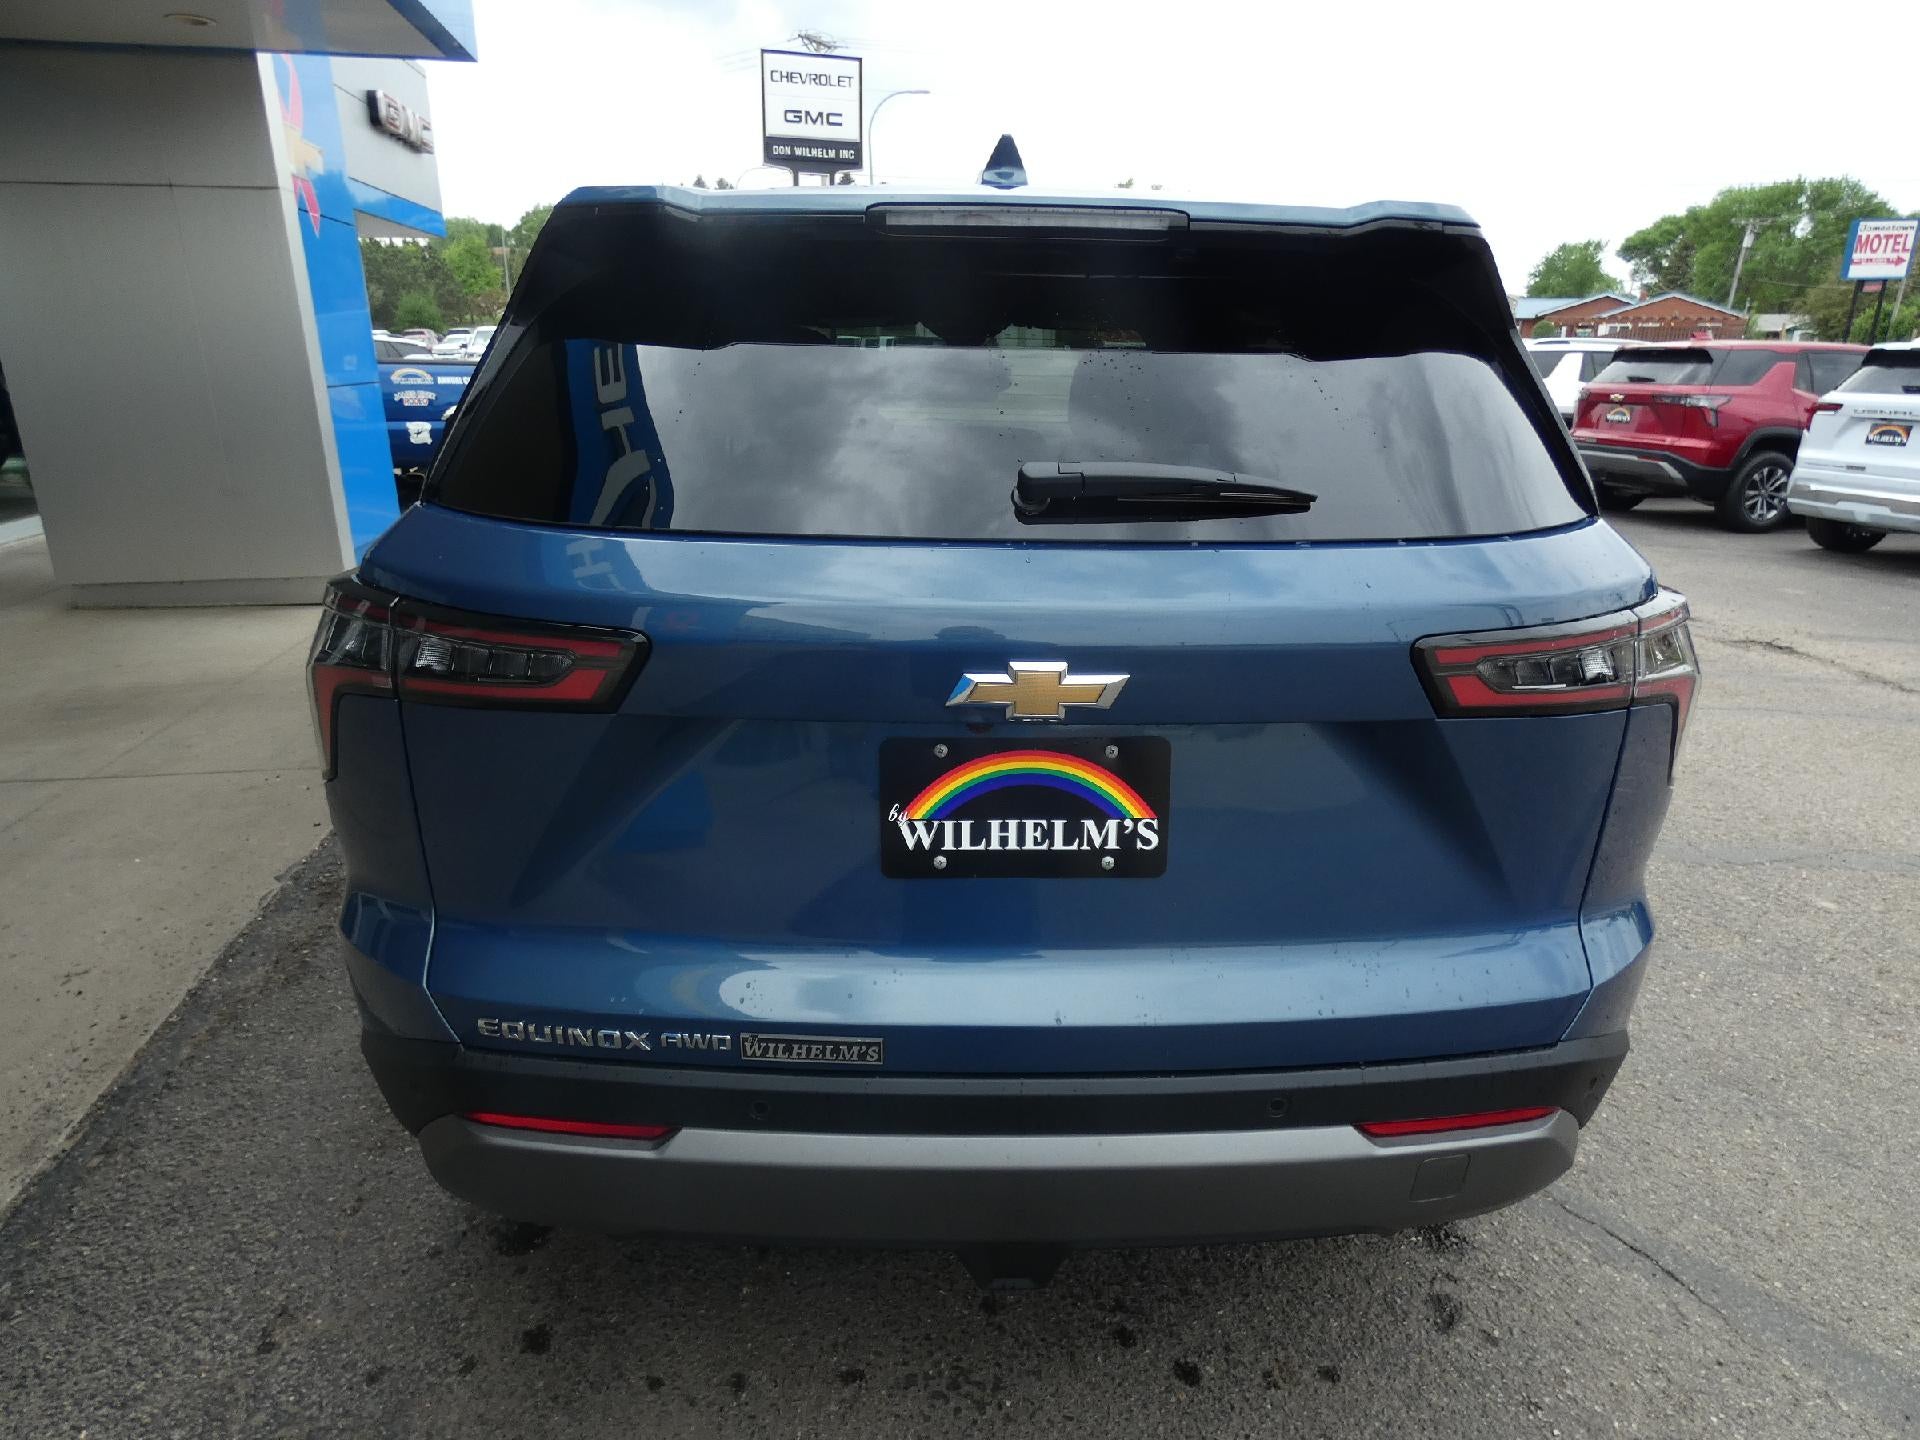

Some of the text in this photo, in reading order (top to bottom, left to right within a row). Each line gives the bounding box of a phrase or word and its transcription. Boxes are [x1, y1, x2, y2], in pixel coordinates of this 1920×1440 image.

[770, 69, 854, 88] CHEVROLET
[784, 109, 843, 127] GMC
[772, 145, 855, 160] DON WILHELM INC
[1854, 233, 1911, 254] MOTEL
[888, 803, 910, 826] by
[899, 817, 1160, 851] WILHELM'S
[476, 1018, 733, 1052] EQUINOX AWD
[744, 1041, 880, 1063] WILHELM'S
